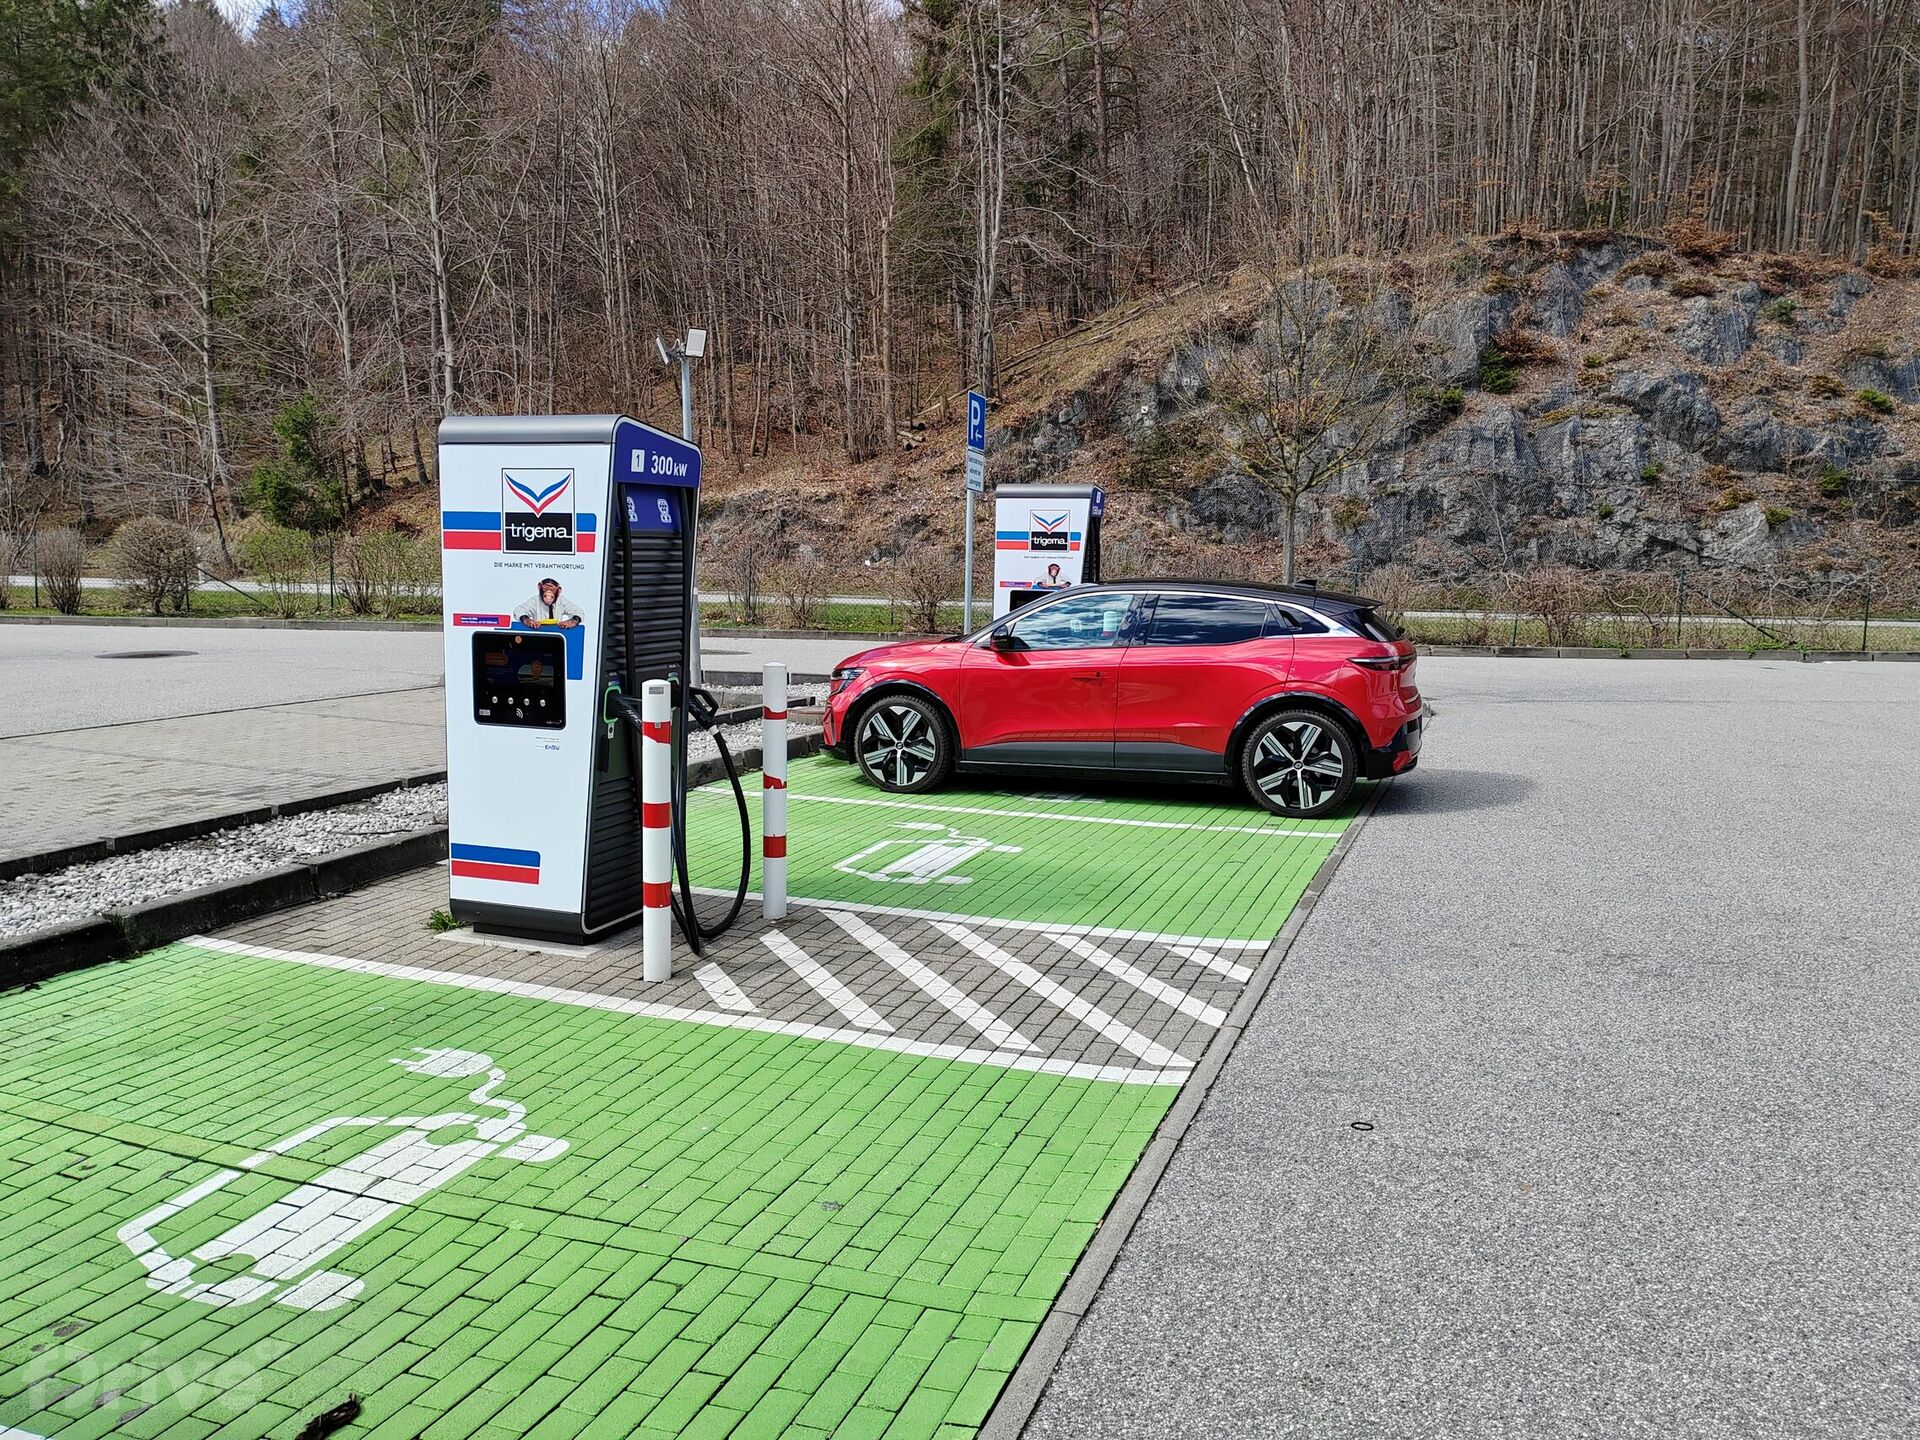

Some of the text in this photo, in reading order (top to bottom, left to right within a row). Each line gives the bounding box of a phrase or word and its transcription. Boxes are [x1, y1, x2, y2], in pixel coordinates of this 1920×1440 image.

[971, 400, 981, 440] P
[511, 523, 568, 542] trigema
[1033, 536, 1066, 547] trigema
[535, 562, 585, 570] VERANTWORTUNG
